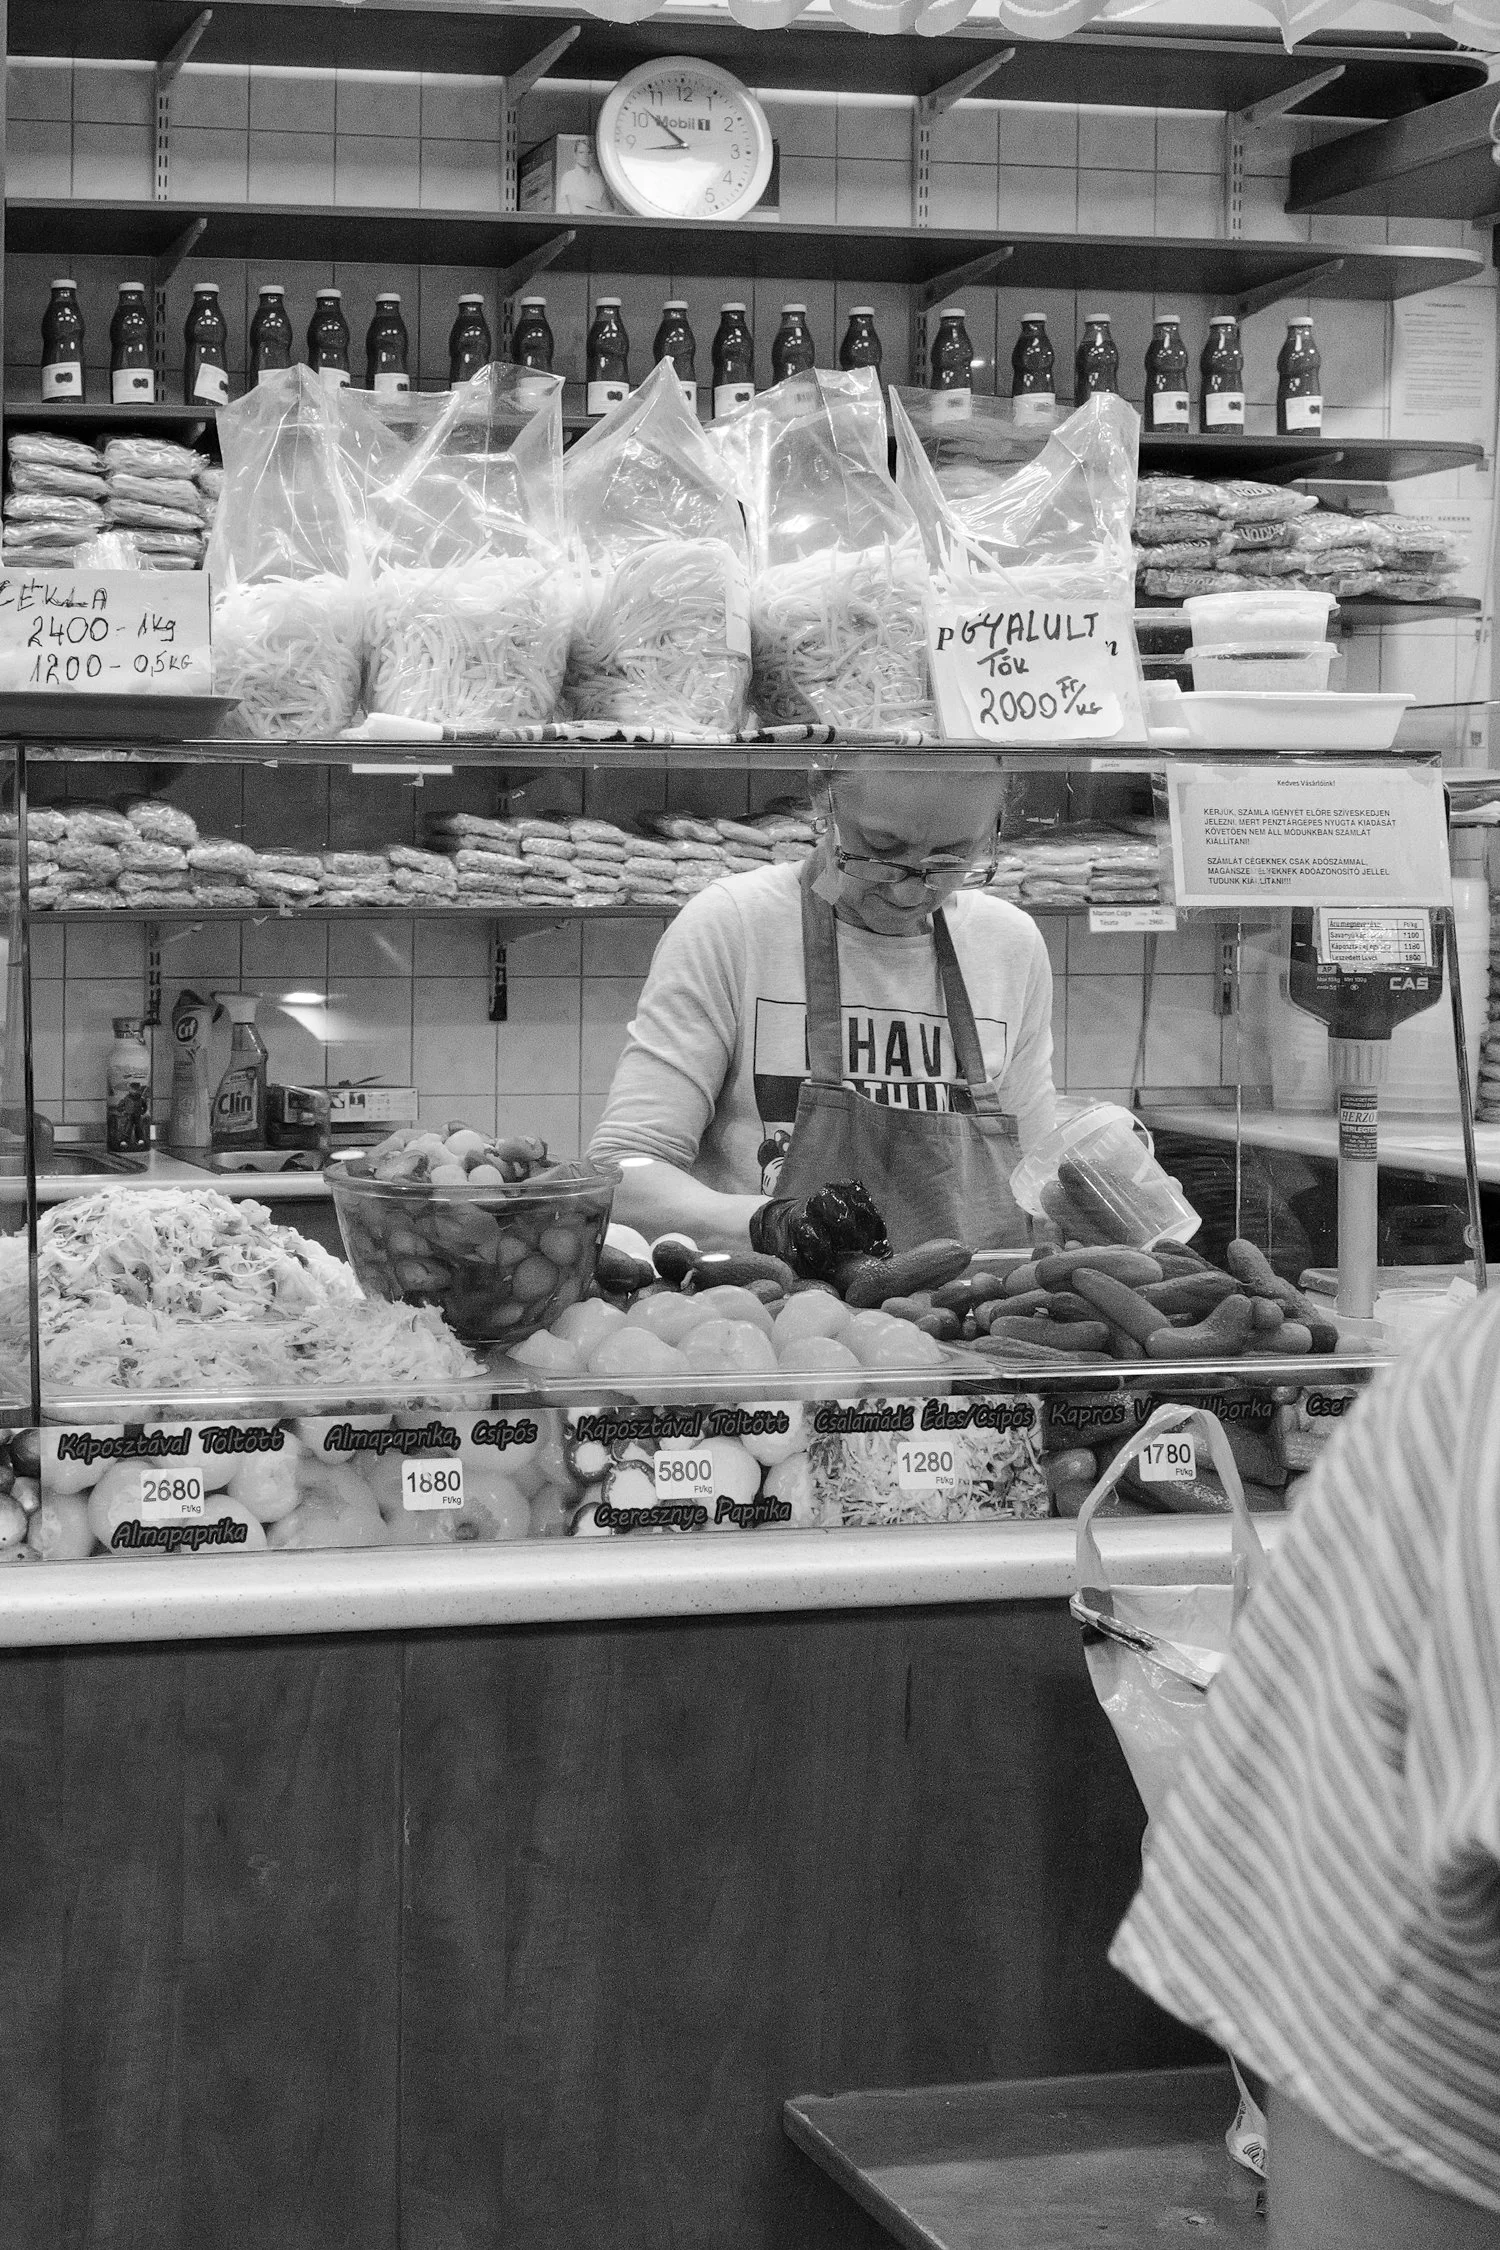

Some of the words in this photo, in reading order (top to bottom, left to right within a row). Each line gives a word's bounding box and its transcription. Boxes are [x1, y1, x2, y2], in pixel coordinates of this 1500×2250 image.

[649, 90, 664, 106] 11
[676, 86, 693, 102] 12
[632, 112, 649, 128] 10
[657, 116, 695, 130] Mobil
[724, 116, 734, 132] 2
[626, 135, 637, 149] 9
[730, 144, 740, 160] 3
[722, 170, 732, 185] 4
[704, 187, 716, 204] 5
[27, 615, 109, 647] 2400
[961, 609, 1099, 650] GYALULT
[29, 653, 102, 685] 1200
[980, 687, 1058, 725] 2000
[1277, 779, 1299, 787] Kedves
[1238, 808, 1269, 816] SZÁMLA
[1272, 808, 1304, 816] IGÉNYÉT
[1333, 809, 1390, 817] SZÍVESKEDJEN
[1358, 819, 1396, 827] KIADÁSÁT
[1207, 857, 1242, 865] SZÁMLÁT
[1245, 857, 1287, 865] CÉGEKNEK
[1300, 867, 1360, 875] ADÓAZONOSÍTÓ
[1209, 877, 1240, 885] TUDUNK
[1389, 977, 1429, 990] CAS
[178, 1019, 197, 1039] Cif
[218, 1091, 252, 1115] Clin
[814, 1404, 914, 1433] Csalamádé
[921, 1398, 1035, 1434] Édes/Csípős
[1049, 1402, 1125, 1430] Kapros
[576, 1411, 701, 1445] Káposztával
[711, 1409, 790, 1436] Töltött
[58, 1428, 192, 1465] Káposztával
[199, 1426, 285, 1454] Töltött
[324, 1421, 461, 1456] Almapaprika,
[471, 1419, 538, 1451] Csípős
[901, 1451, 953, 1473] 1280
[1143, 1443, 1191, 1465] 1780
[658, 1459, 712, 1482] 5800
[1175, 1467, 1194, 1478] Ft/kg
[406, 1470, 461, 1494] 1880
[935, 1476, 954, 1486] Ft/kg
[142, 1478, 201, 1503] 2680
[694, 1485, 713, 1494] Ft/kg
[442, 1496, 462, 1505] Ft/kg
[181, 1504, 202, 1514] Ft/kg
[594, 1502, 708, 1531] Cseresznye
[714, 1494, 793, 1529] Paprika
[111, 1516, 248, 1551] Almapaprika
